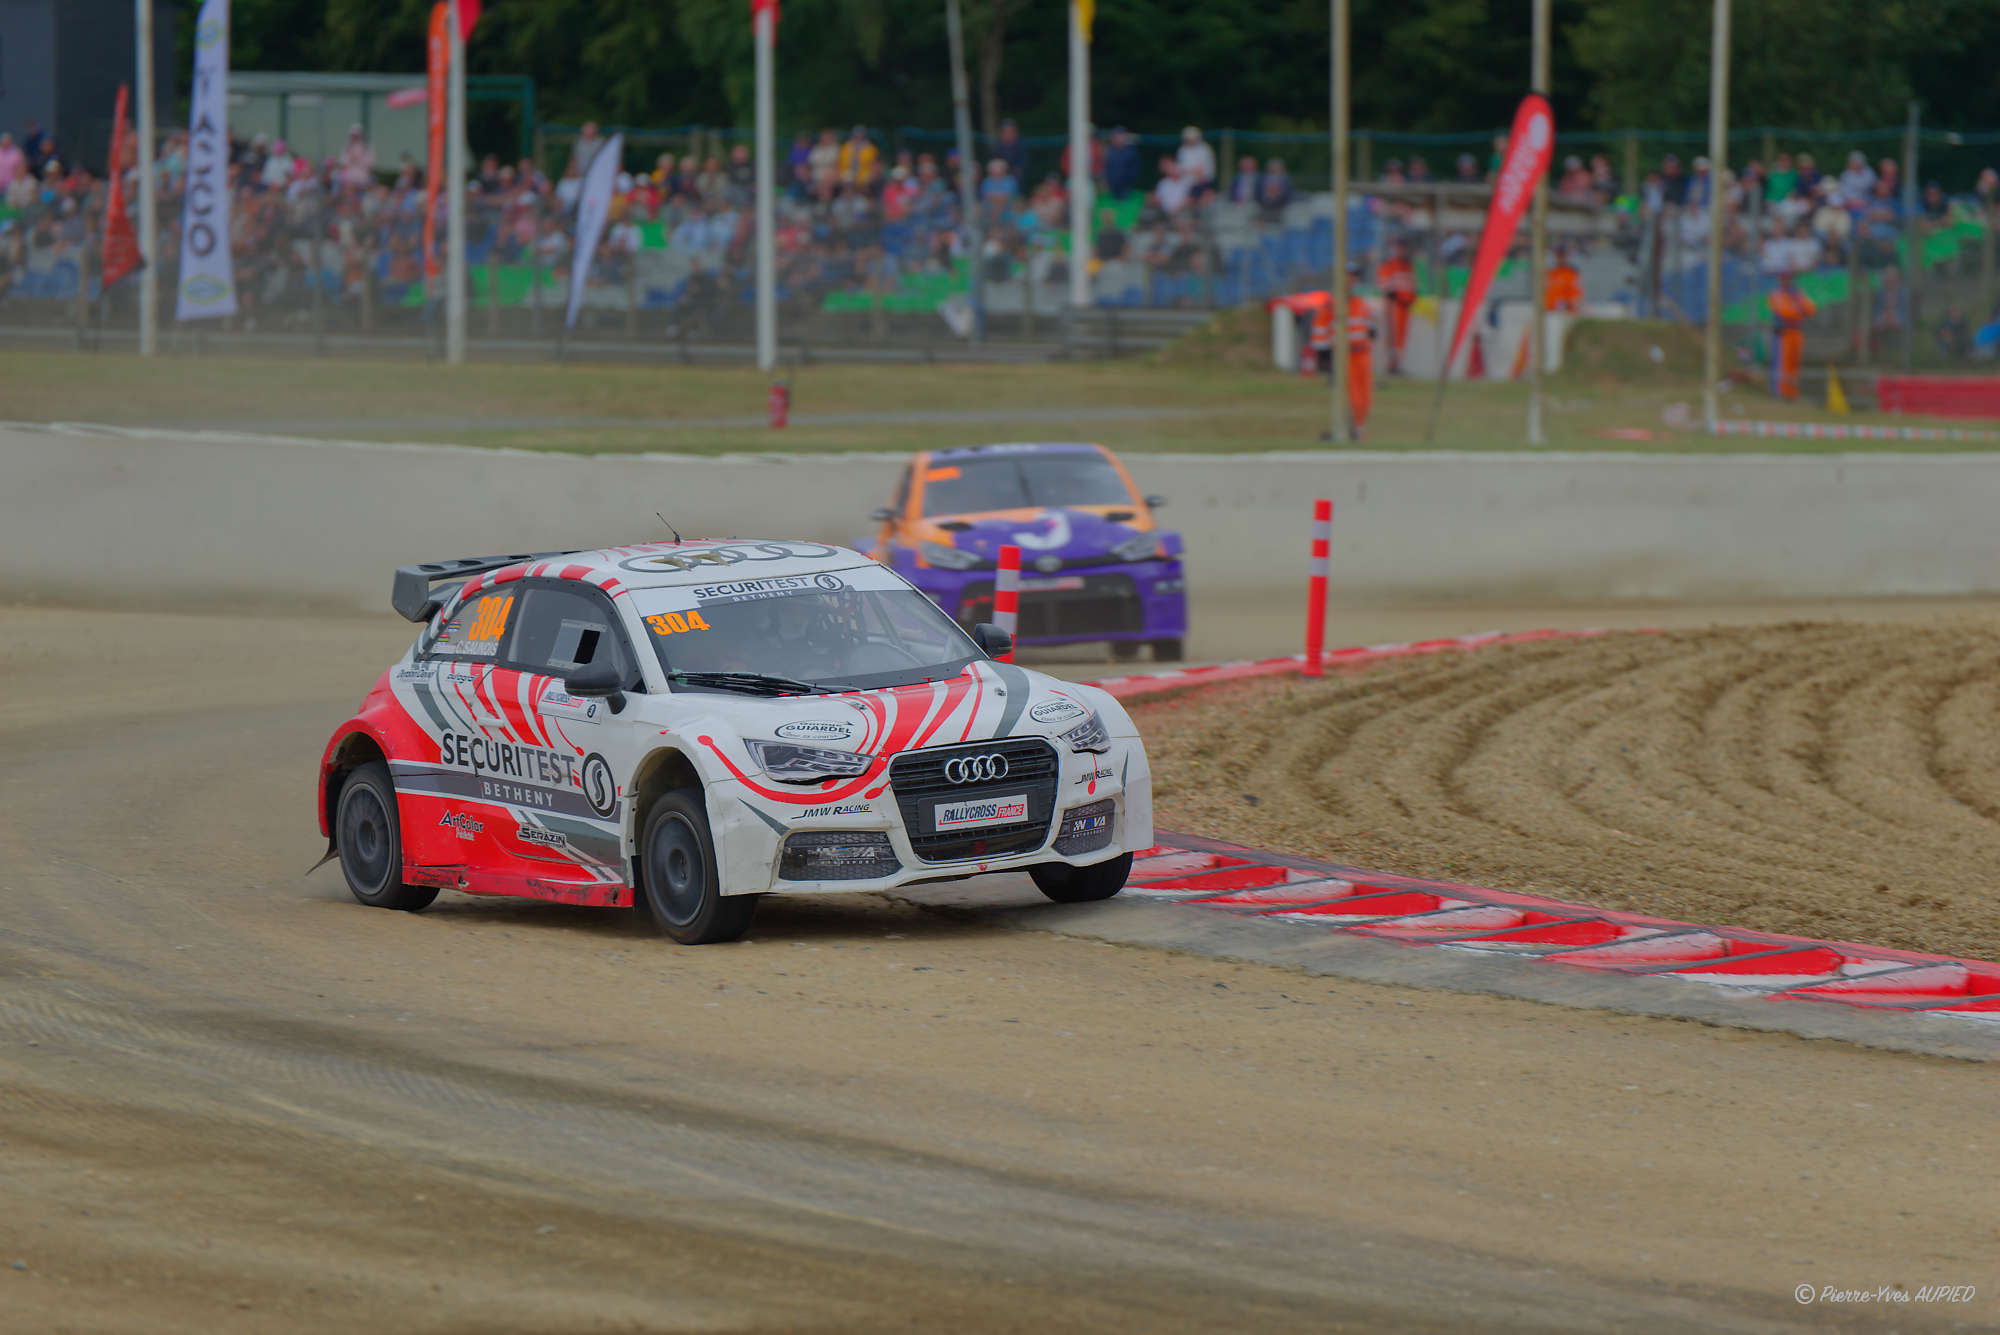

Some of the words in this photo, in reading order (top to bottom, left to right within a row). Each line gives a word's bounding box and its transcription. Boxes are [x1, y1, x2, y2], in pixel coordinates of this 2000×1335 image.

[693, 576, 809, 599] SECURITEST
[732, 590, 794, 602] BETHENY
[469, 595, 514, 641] 304
[646, 610, 713, 636] 304
[786, 725, 852, 734] GUIARDEL
[442, 732, 577, 787] SECURITEST
[484, 781, 553, 807] BETHENY
[797, 806, 832, 819] JMW
[943, 803, 997, 822] RALLYCROSS
